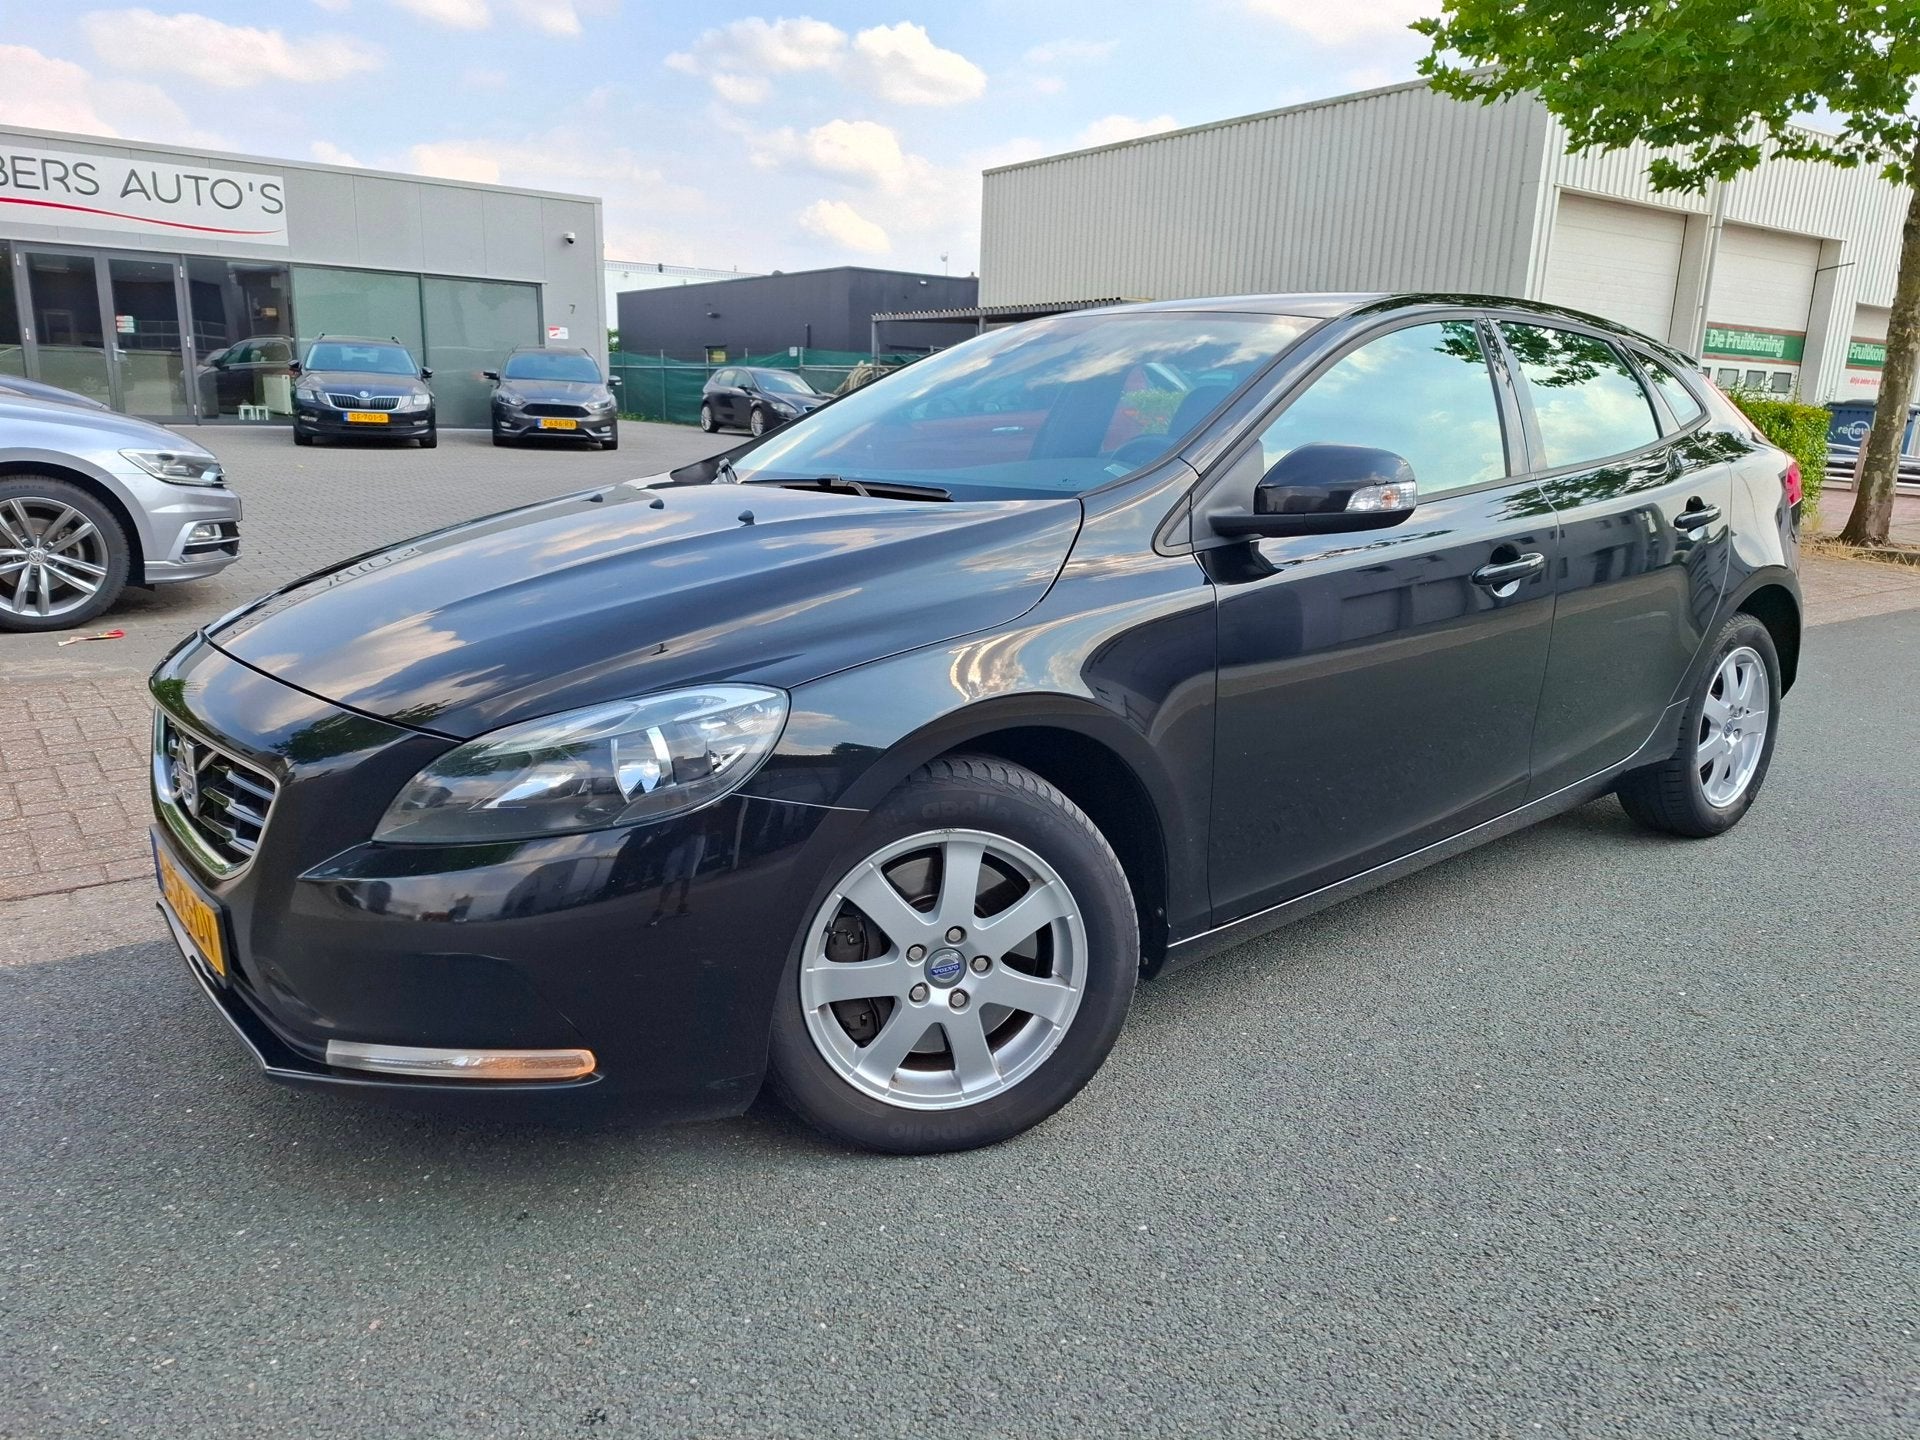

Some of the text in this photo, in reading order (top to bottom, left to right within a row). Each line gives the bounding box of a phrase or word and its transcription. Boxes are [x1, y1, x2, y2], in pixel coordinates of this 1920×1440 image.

[120, 168, 284, 214] AUTO'S
[569, 304, 576, 315] 7
[1708, 329, 1785, 358] De Fruitkoning
[932, 964, 959, 974] VOLVO
